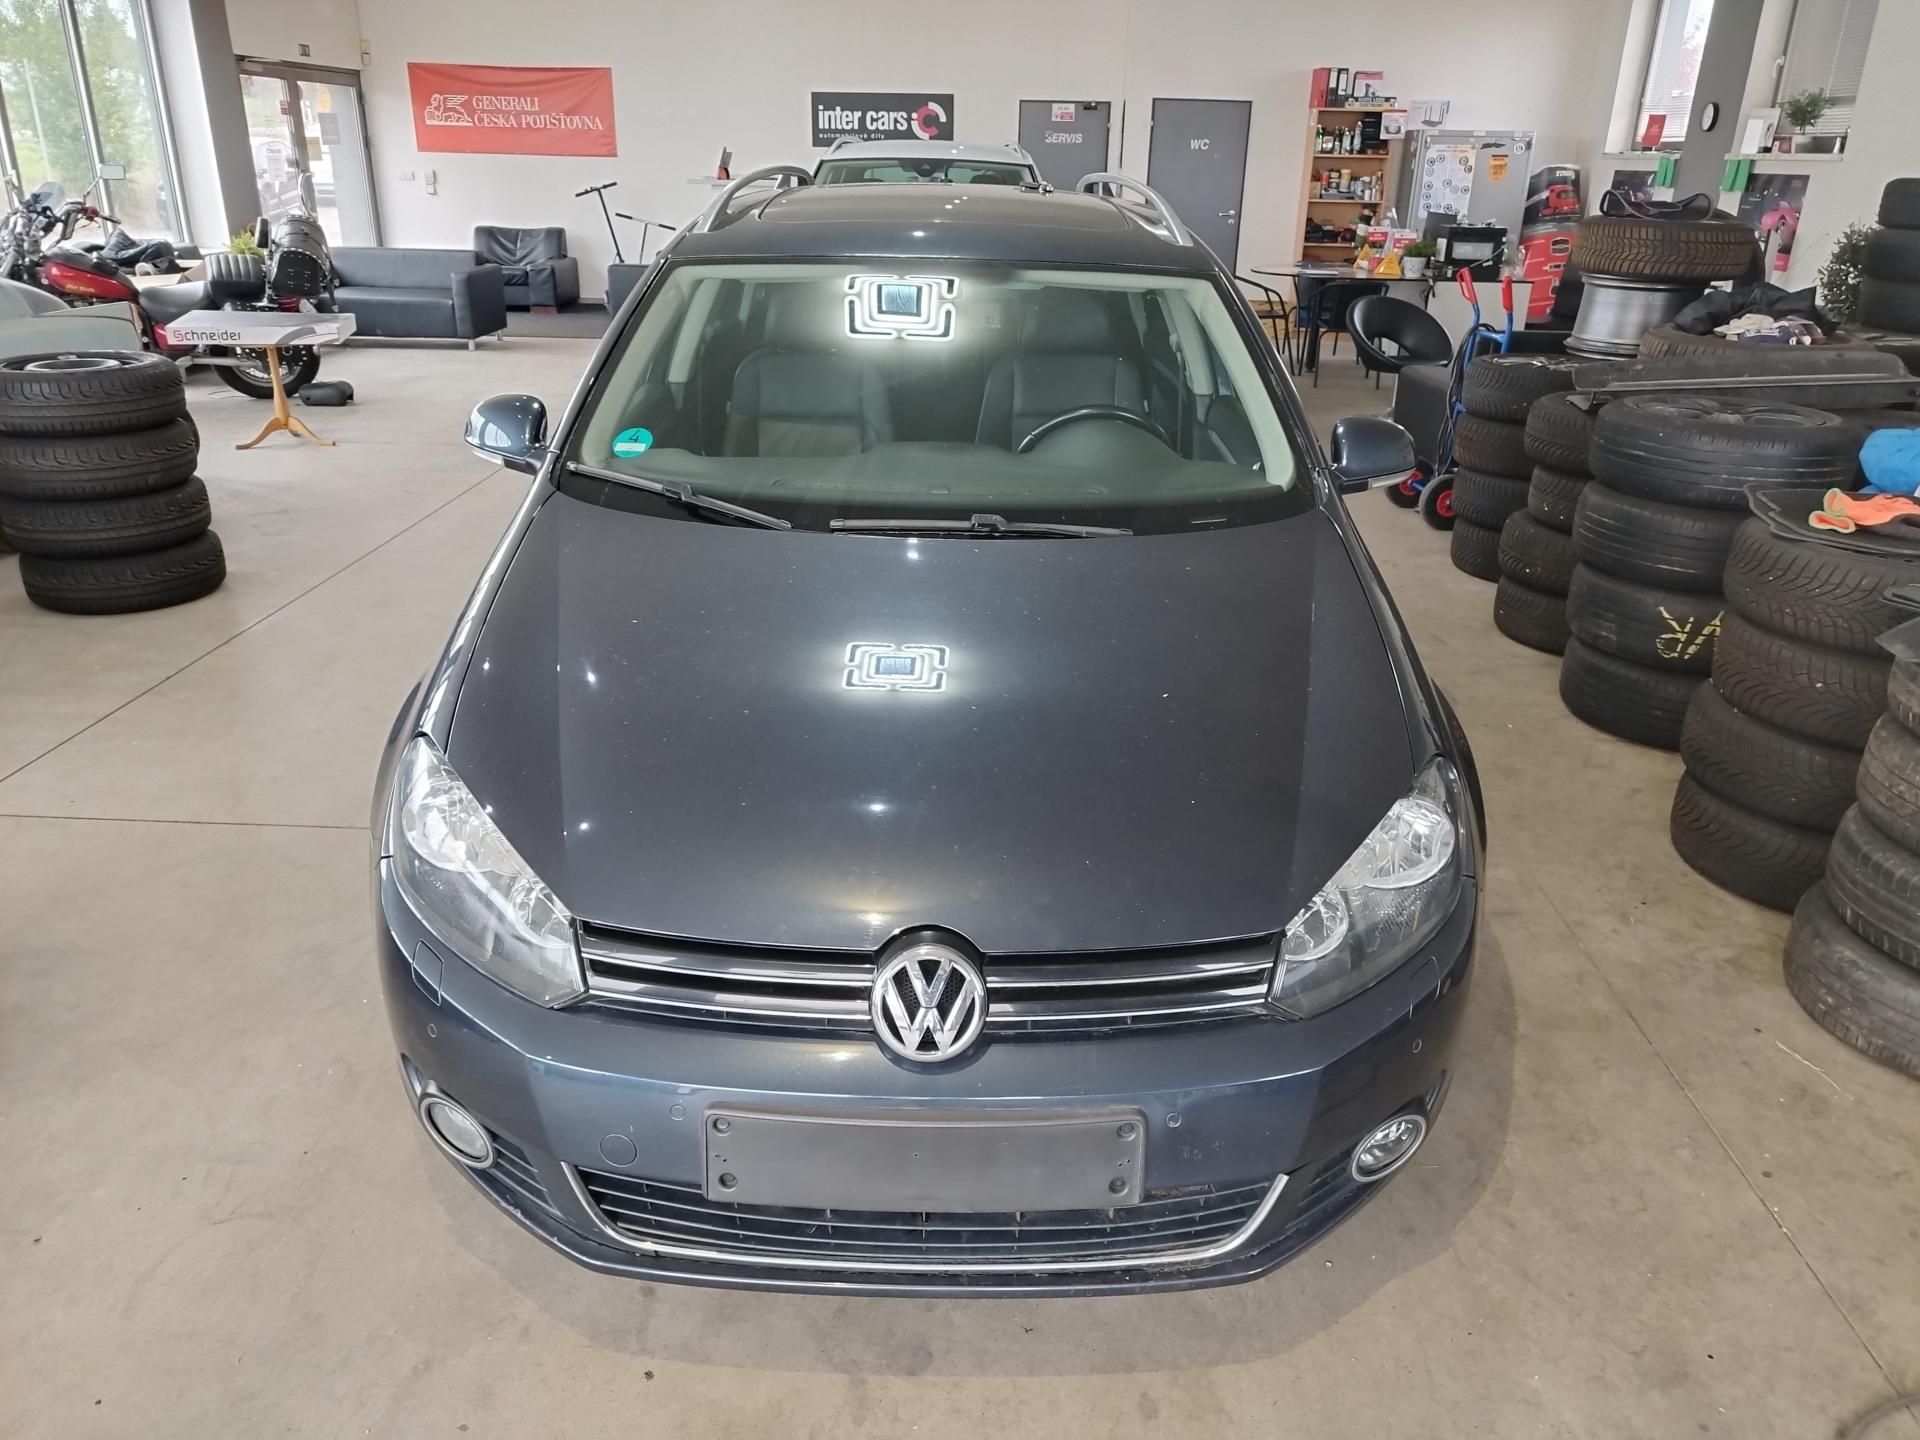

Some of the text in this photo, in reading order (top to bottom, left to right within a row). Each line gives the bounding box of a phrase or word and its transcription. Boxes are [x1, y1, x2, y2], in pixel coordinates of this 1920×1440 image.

[472, 95, 540, 111] GENERALI
[474, 110, 603, 130] ČESKÁ POJIŠŤOVNA
[818, 104, 909, 131] inter cars
[1044, 131, 1084, 144] SERVIS
[1189, 138, 1211, 151] WC
[172, 328, 242, 342] Schneider
[627, 428, 641, 443] 4
[876, 953, 981, 1059] VW
